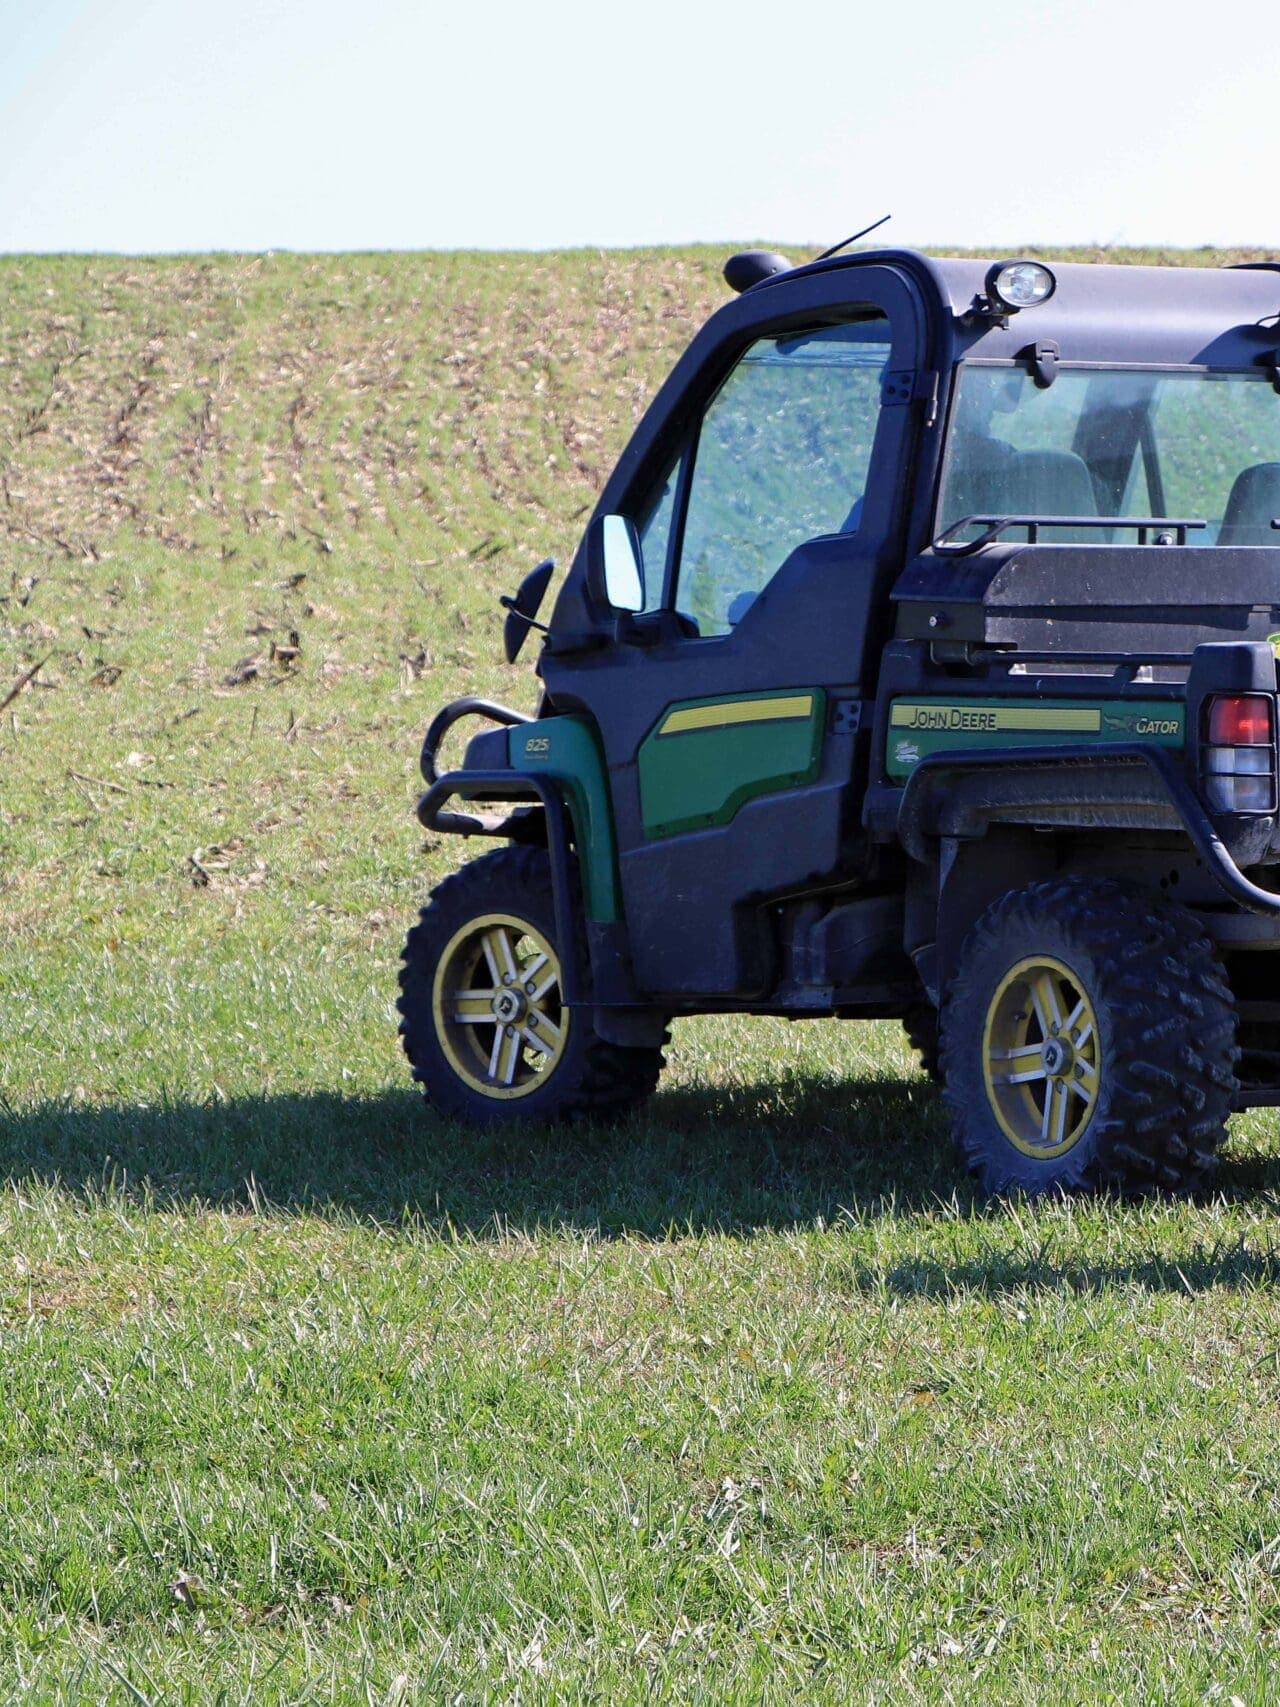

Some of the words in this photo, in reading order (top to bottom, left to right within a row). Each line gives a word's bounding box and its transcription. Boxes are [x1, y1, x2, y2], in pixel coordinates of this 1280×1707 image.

[909, 707, 948, 727] JOHN
[950, 708, 997, 729] DEERE
[1136, 717, 1179, 734] GATOR
